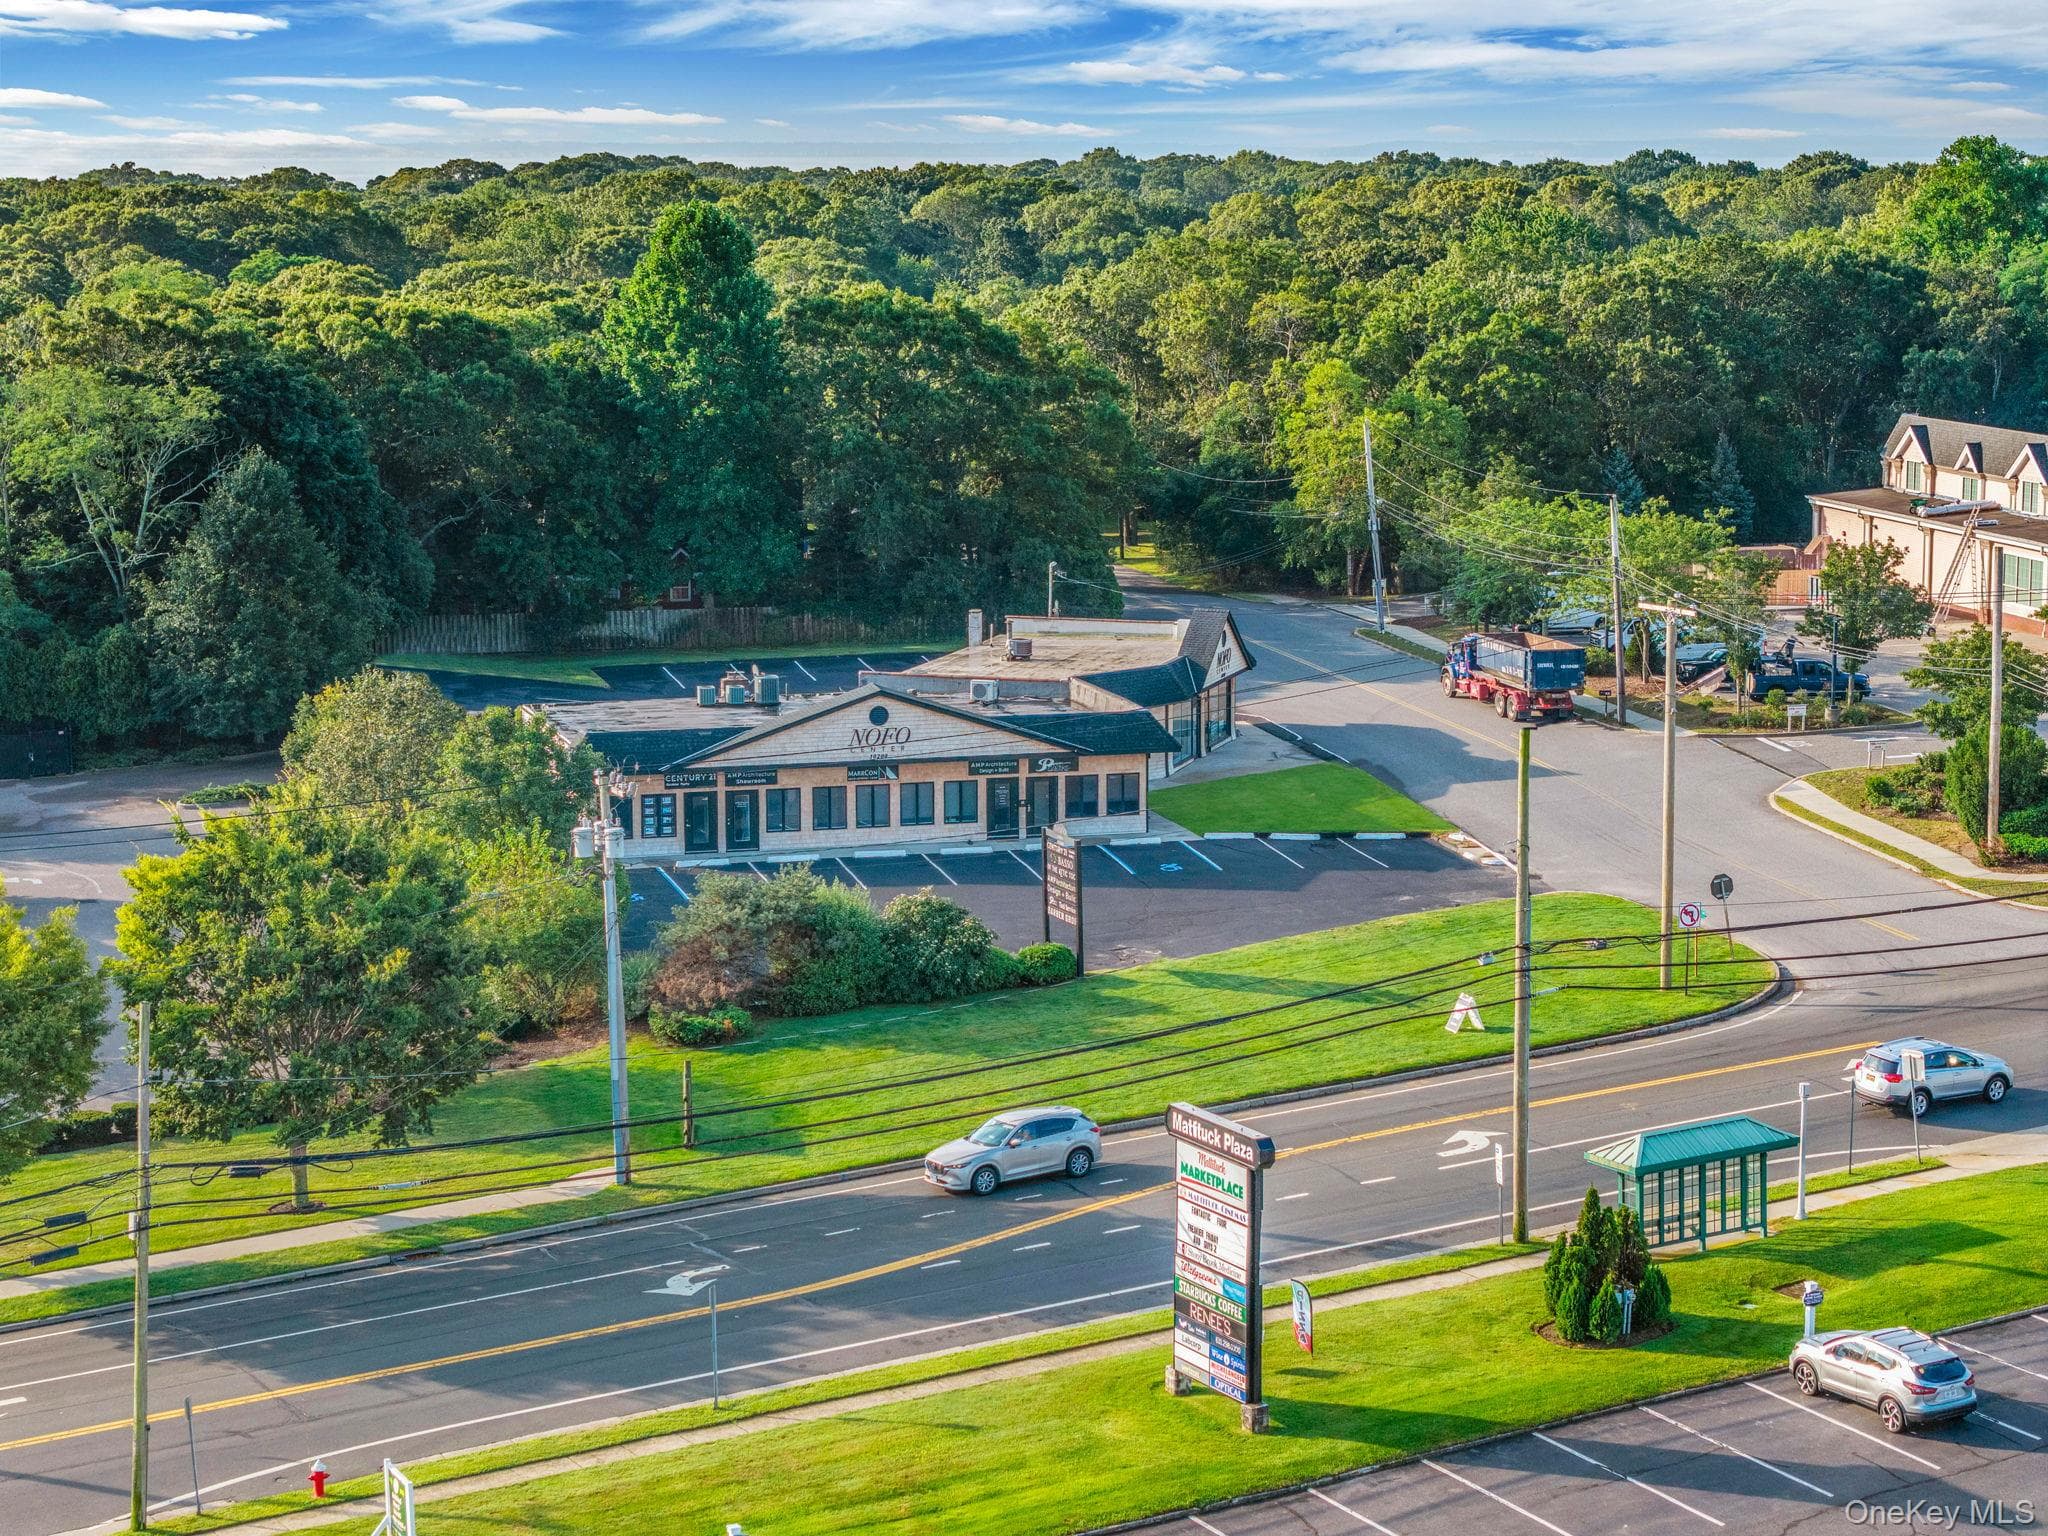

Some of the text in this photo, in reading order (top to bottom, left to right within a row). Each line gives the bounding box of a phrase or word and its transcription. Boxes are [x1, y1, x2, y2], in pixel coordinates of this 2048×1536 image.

[848, 727, 911, 746] NOFO
[850, 745, 905, 753] CENTER
[665, 773, 717, 782] CENTURY 21
[1172, 1111, 1254, 1161] Mattituck Plaza
[1180, 1161, 1244, 1199] MARKETPLACE
[1181, 1260, 1217, 1286] Walgreens
[1179, 1280, 1216, 1307] STARBUCKS
[1218, 1298, 1243, 1319] COFFEE
[1190, 1302, 1231, 1336] RENEE'S
[1214, 1379, 1242, 1400] OPTICAL
